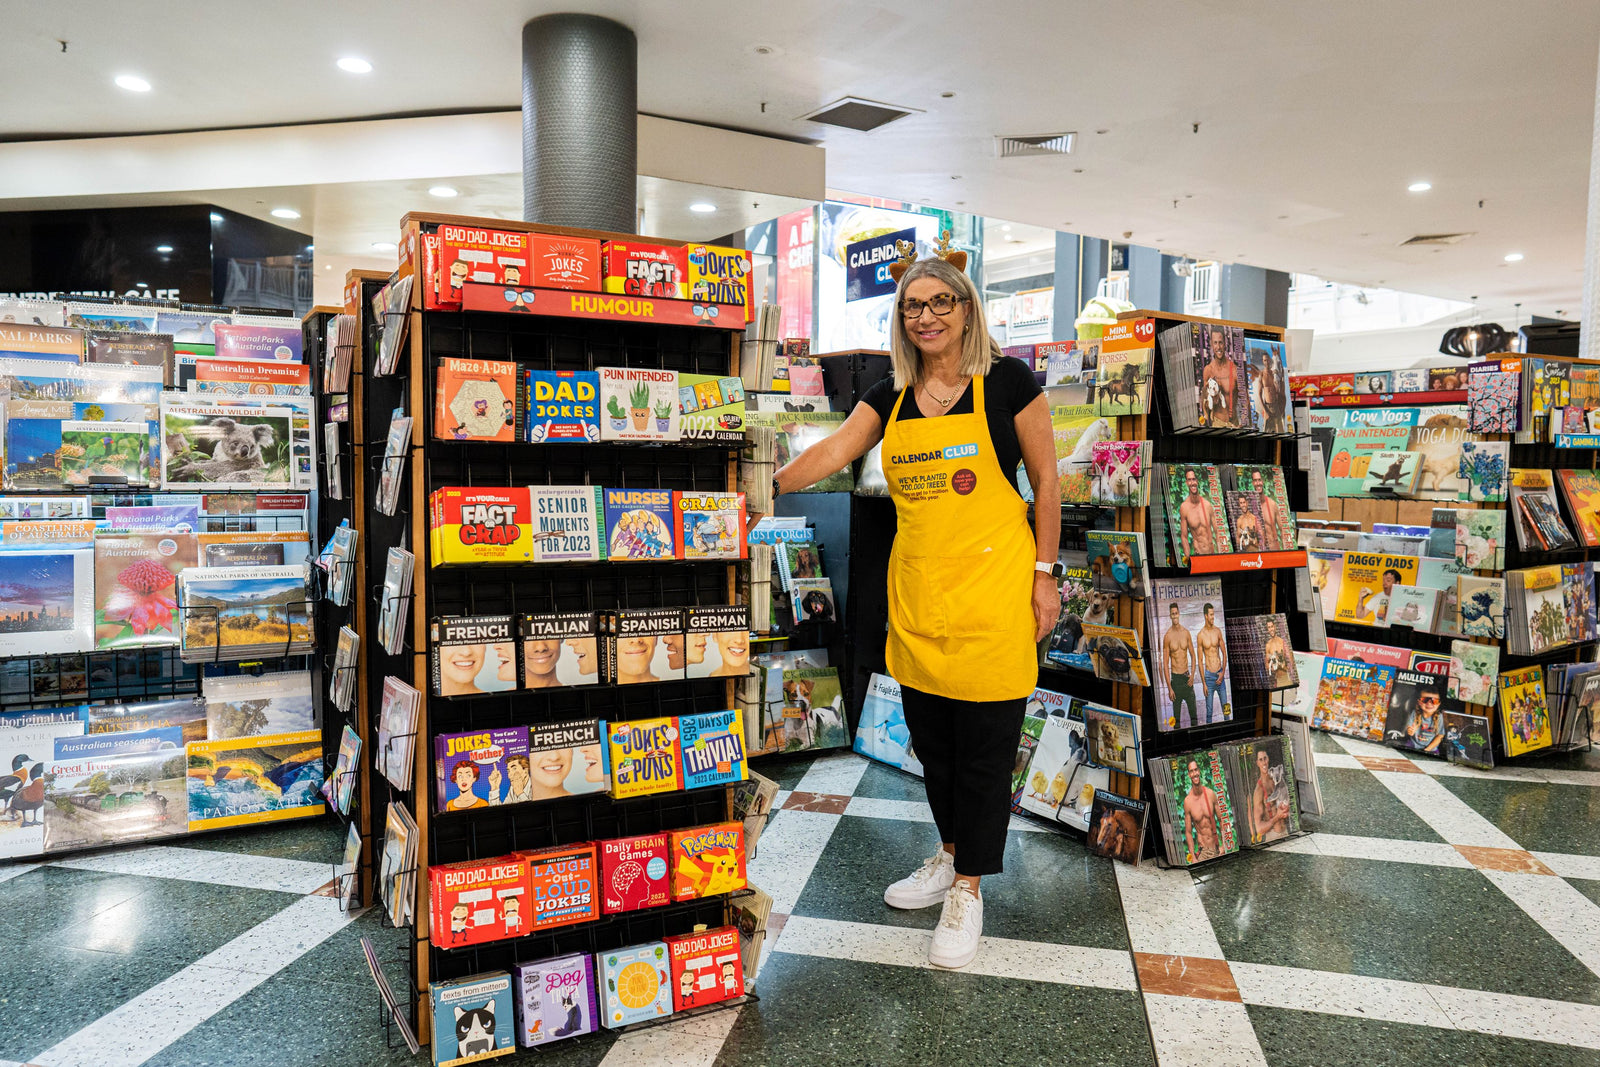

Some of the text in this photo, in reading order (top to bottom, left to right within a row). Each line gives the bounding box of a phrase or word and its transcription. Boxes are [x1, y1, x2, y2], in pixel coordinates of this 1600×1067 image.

[445, 228, 521, 248] BAD DAD JOKES
[551, 258, 584, 273] JOKES
[627, 259, 675, 282] FACT
[699, 252, 745, 278] JOKES
[625, 279, 678, 298] CRAP
[708, 282, 745, 304] PUNS
[571, 296, 654, 318] HUMOUR
[1109, 322, 1153, 335] MINI $10
[30, 332, 73, 344] PARKS
[224, 334, 285, 344] National Parks
[1104, 333, 1133, 342] CALENDARS
[110, 343, 156, 351] AUSTRALIAN
[234, 343, 272, 352] Australia
[1049, 360, 1079, 371] HORSES
[1100, 353, 1128, 364] HORSES
[209, 364, 300, 377] Australian Dreaming
[604, 370, 674, 383] PUN INTENDED
[1470, 365, 1499, 373] DIARIES
[536, 381, 595, 402] DAD
[1341, 396, 1361, 404] LOL!
[169, 407, 267, 416] AUSTRALIAN WILDLIFE
[536, 406, 594, 418] JOKES
[776, 413, 845, 423] JACK RUSSELLS
[1351, 410, 1412, 423] Cow Yoga
[1310, 415, 1330, 424] Yoga
[680, 415, 715, 440] 2023
[1337, 428, 1408, 438] PUN INTENDED
[717, 433, 743, 441] CALENDAR
[1417, 428, 1446, 444] YOGA
[1573, 437, 1594, 445] GAMING
[892, 445, 977, 465] CALENDAR CLUB
[899, 473, 948, 484] WE'VE PLANTED
[927, 481, 946, 489] TREES!
[539, 498, 588, 514] SENIOR
[609, 492, 670, 505] NURSES
[678, 497, 742, 511] CRACK
[461, 503, 517, 525] FACT
[15, 525, 85, 533] COASTLINES
[540, 517, 589, 532] MOMENTS
[29, 531, 90, 539] AUSTRALIA
[459, 524, 520, 546] CRAP
[749, 529, 812, 541] JUST CORGIS
[542, 536, 591, 553] FOR 2023
[106, 549, 149, 557] Australia
[1348, 555, 1383, 567] DAGGY
[1385, 558, 1414, 570] DADS
[1066, 568, 1088, 578] JUST
[1159, 584, 1221, 599] FIREFIGHTERS
[531, 620, 589, 635] ITALIAN
[621, 618, 680, 632] SPANISH
[690, 615, 746, 628] GERMAN
[446, 625, 509, 640] FRENCH
[1326, 663, 1371, 679] BIGFOOT
[1398, 672, 1435, 685] MULLETS
[879, 683, 892, 696] Fragile
[1034, 690, 1064, 706] COWS
[58, 712, 75, 722] Art
[698, 713, 735, 729] DAYS OF
[97, 720, 170, 734] AUSTRALIA
[683, 719, 697, 741] 365
[1053, 718, 1083, 733] PUPPIES
[61, 736, 161, 753] Australian seascapes
[446, 733, 492, 757] JOKES
[534, 728, 594, 747] FRENCH
[623, 725, 672, 754] JOKES
[470, 747, 505, 761] Mother!
[685, 735, 741, 773] TRIVIA!
[51, 764, 82, 775] Great
[633, 754, 673, 782] PUNS
[694, 770, 736, 784] 2023 CALENDAR
[204, 795, 314, 818] PANOSCAPES
[1124, 799, 1138, 808] Teach
[1209, 752, 1235, 850] FIREFIGHTERS
[606, 838, 665, 854] Daily BRAIN
[619, 850, 653, 861] Games
[534, 859, 590, 877] LAUGH
[445, 865, 519, 887] BAD DAD JOKES
[535, 879, 591, 900] LOUD
[536, 893, 592, 912] JOKES
[674, 934, 733, 955] BAD DAD JOKES
[546, 970, 585, 994] Dog
[443, 991, 462, 1000] texts
[463, 988, 480, 996] from
[482, 982, 507, 993] mittens
